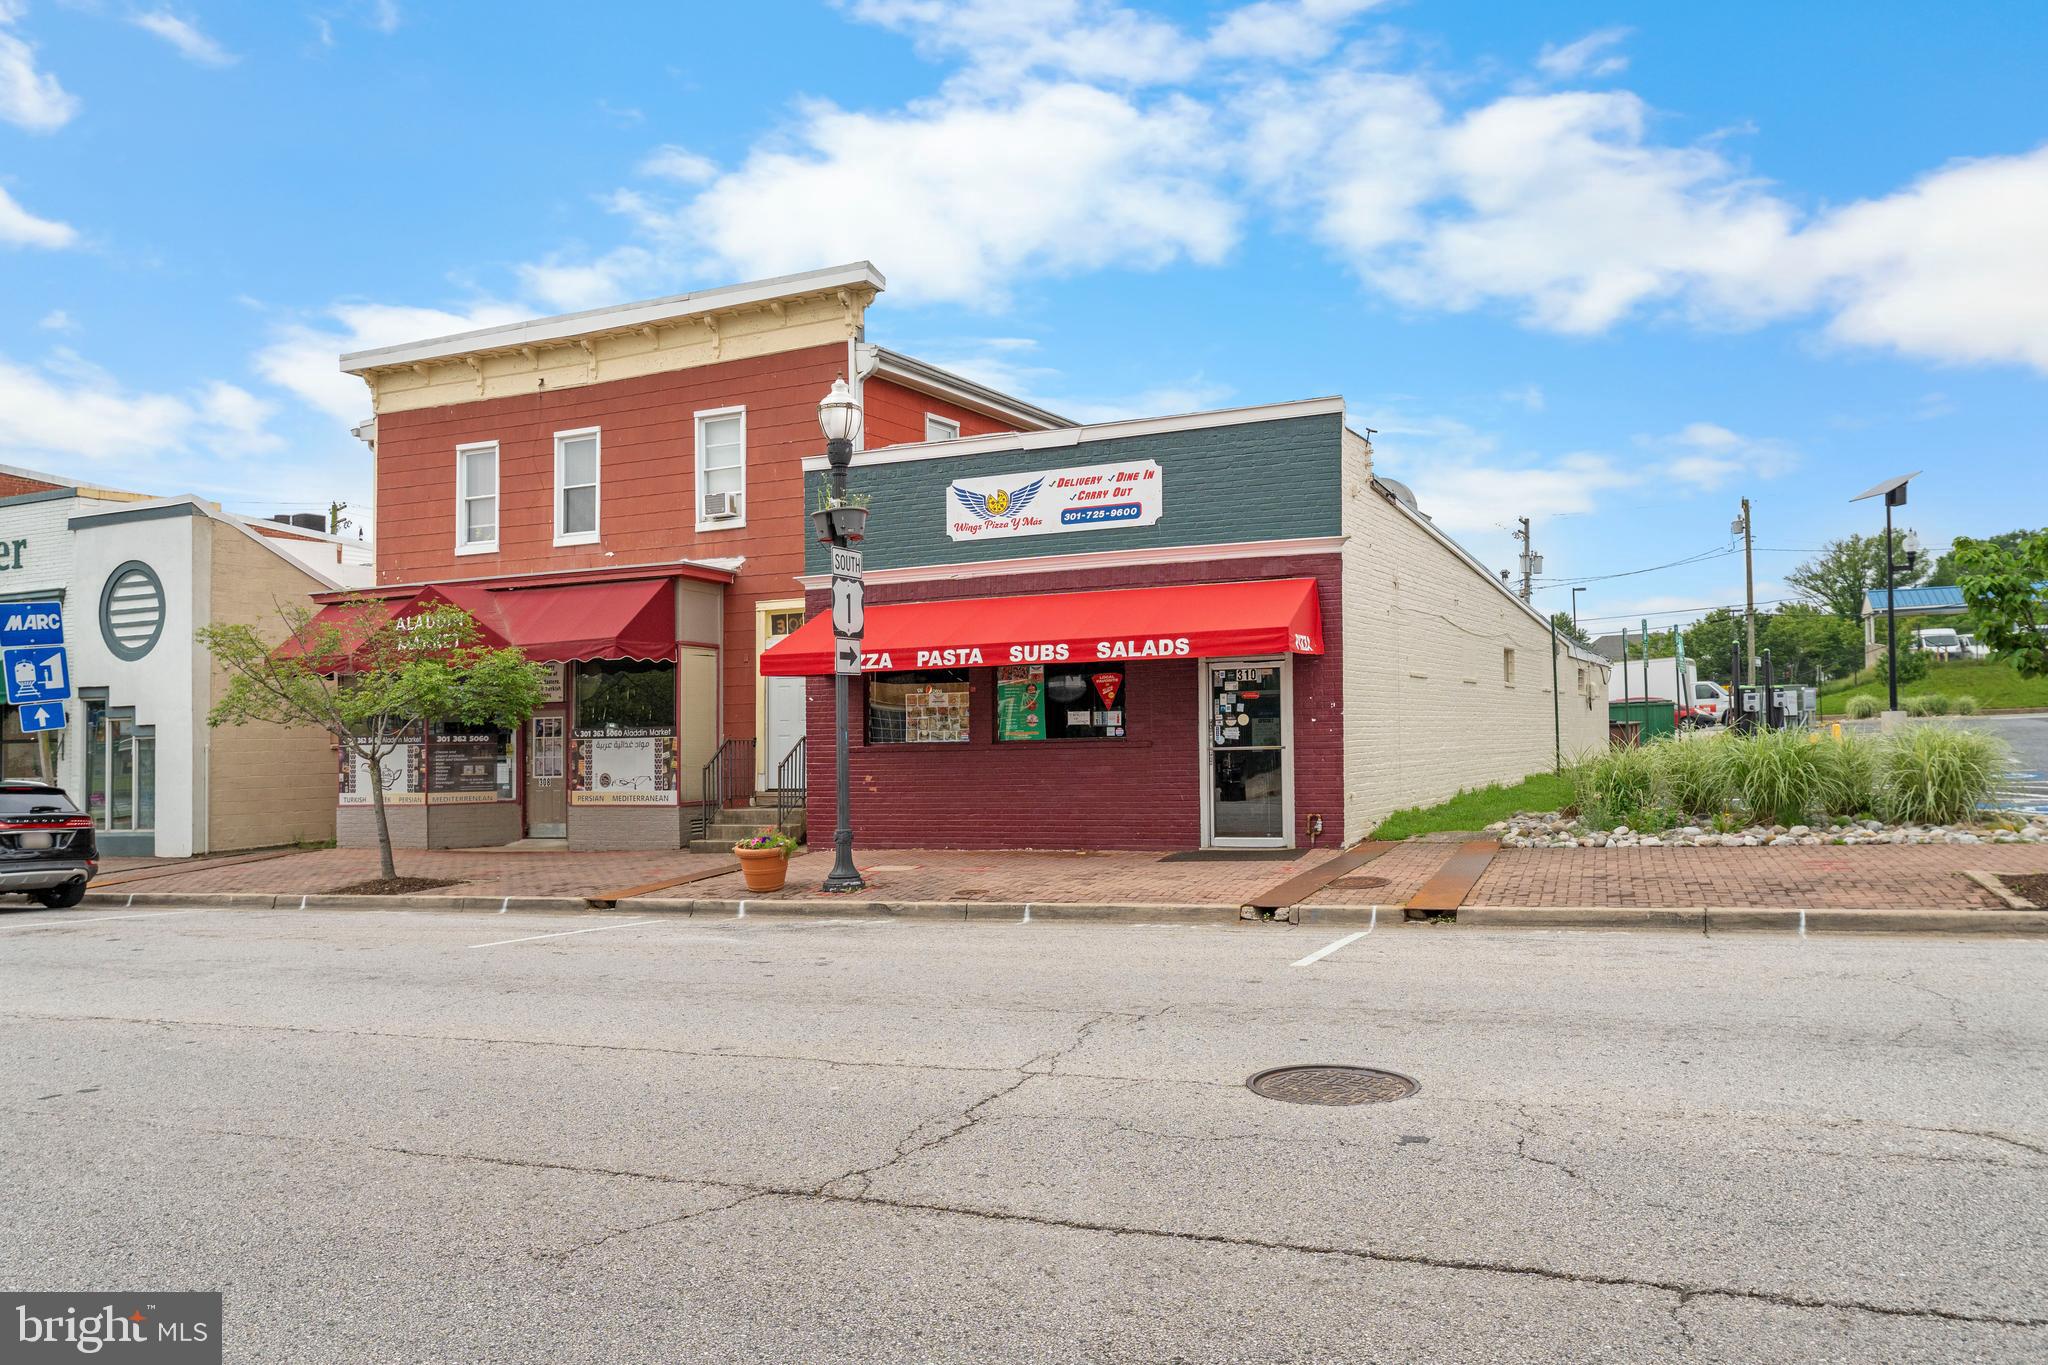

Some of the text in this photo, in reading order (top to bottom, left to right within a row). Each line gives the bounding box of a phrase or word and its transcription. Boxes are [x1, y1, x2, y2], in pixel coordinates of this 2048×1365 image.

[1057, 469, 1155, 488] DELIVERY DINE IN
[1077, 487, 1133, 501] CARRY OUT
[1063, 507, 1138, 521] 301-725-9600
[953, 522, 982, 535] Wings
[984, 519, 1009, 530] Pizza
[834, 553, 860, 574] SOUTH
[846, 592, 851, 624] 1
[4, 613, 60, 631] MARC
[861, 637, 1190, 669] ZZA PASTA SUBS SALADS
[1237, 668, 1257, 680] 310
[436, 735, 450, 743] 301
[580, 730, 591, 738] 301
[606, 729, 622, 737] 5060
[623, 729, 648, 737] Aladdin
[649, 728, 671, 736] Market
